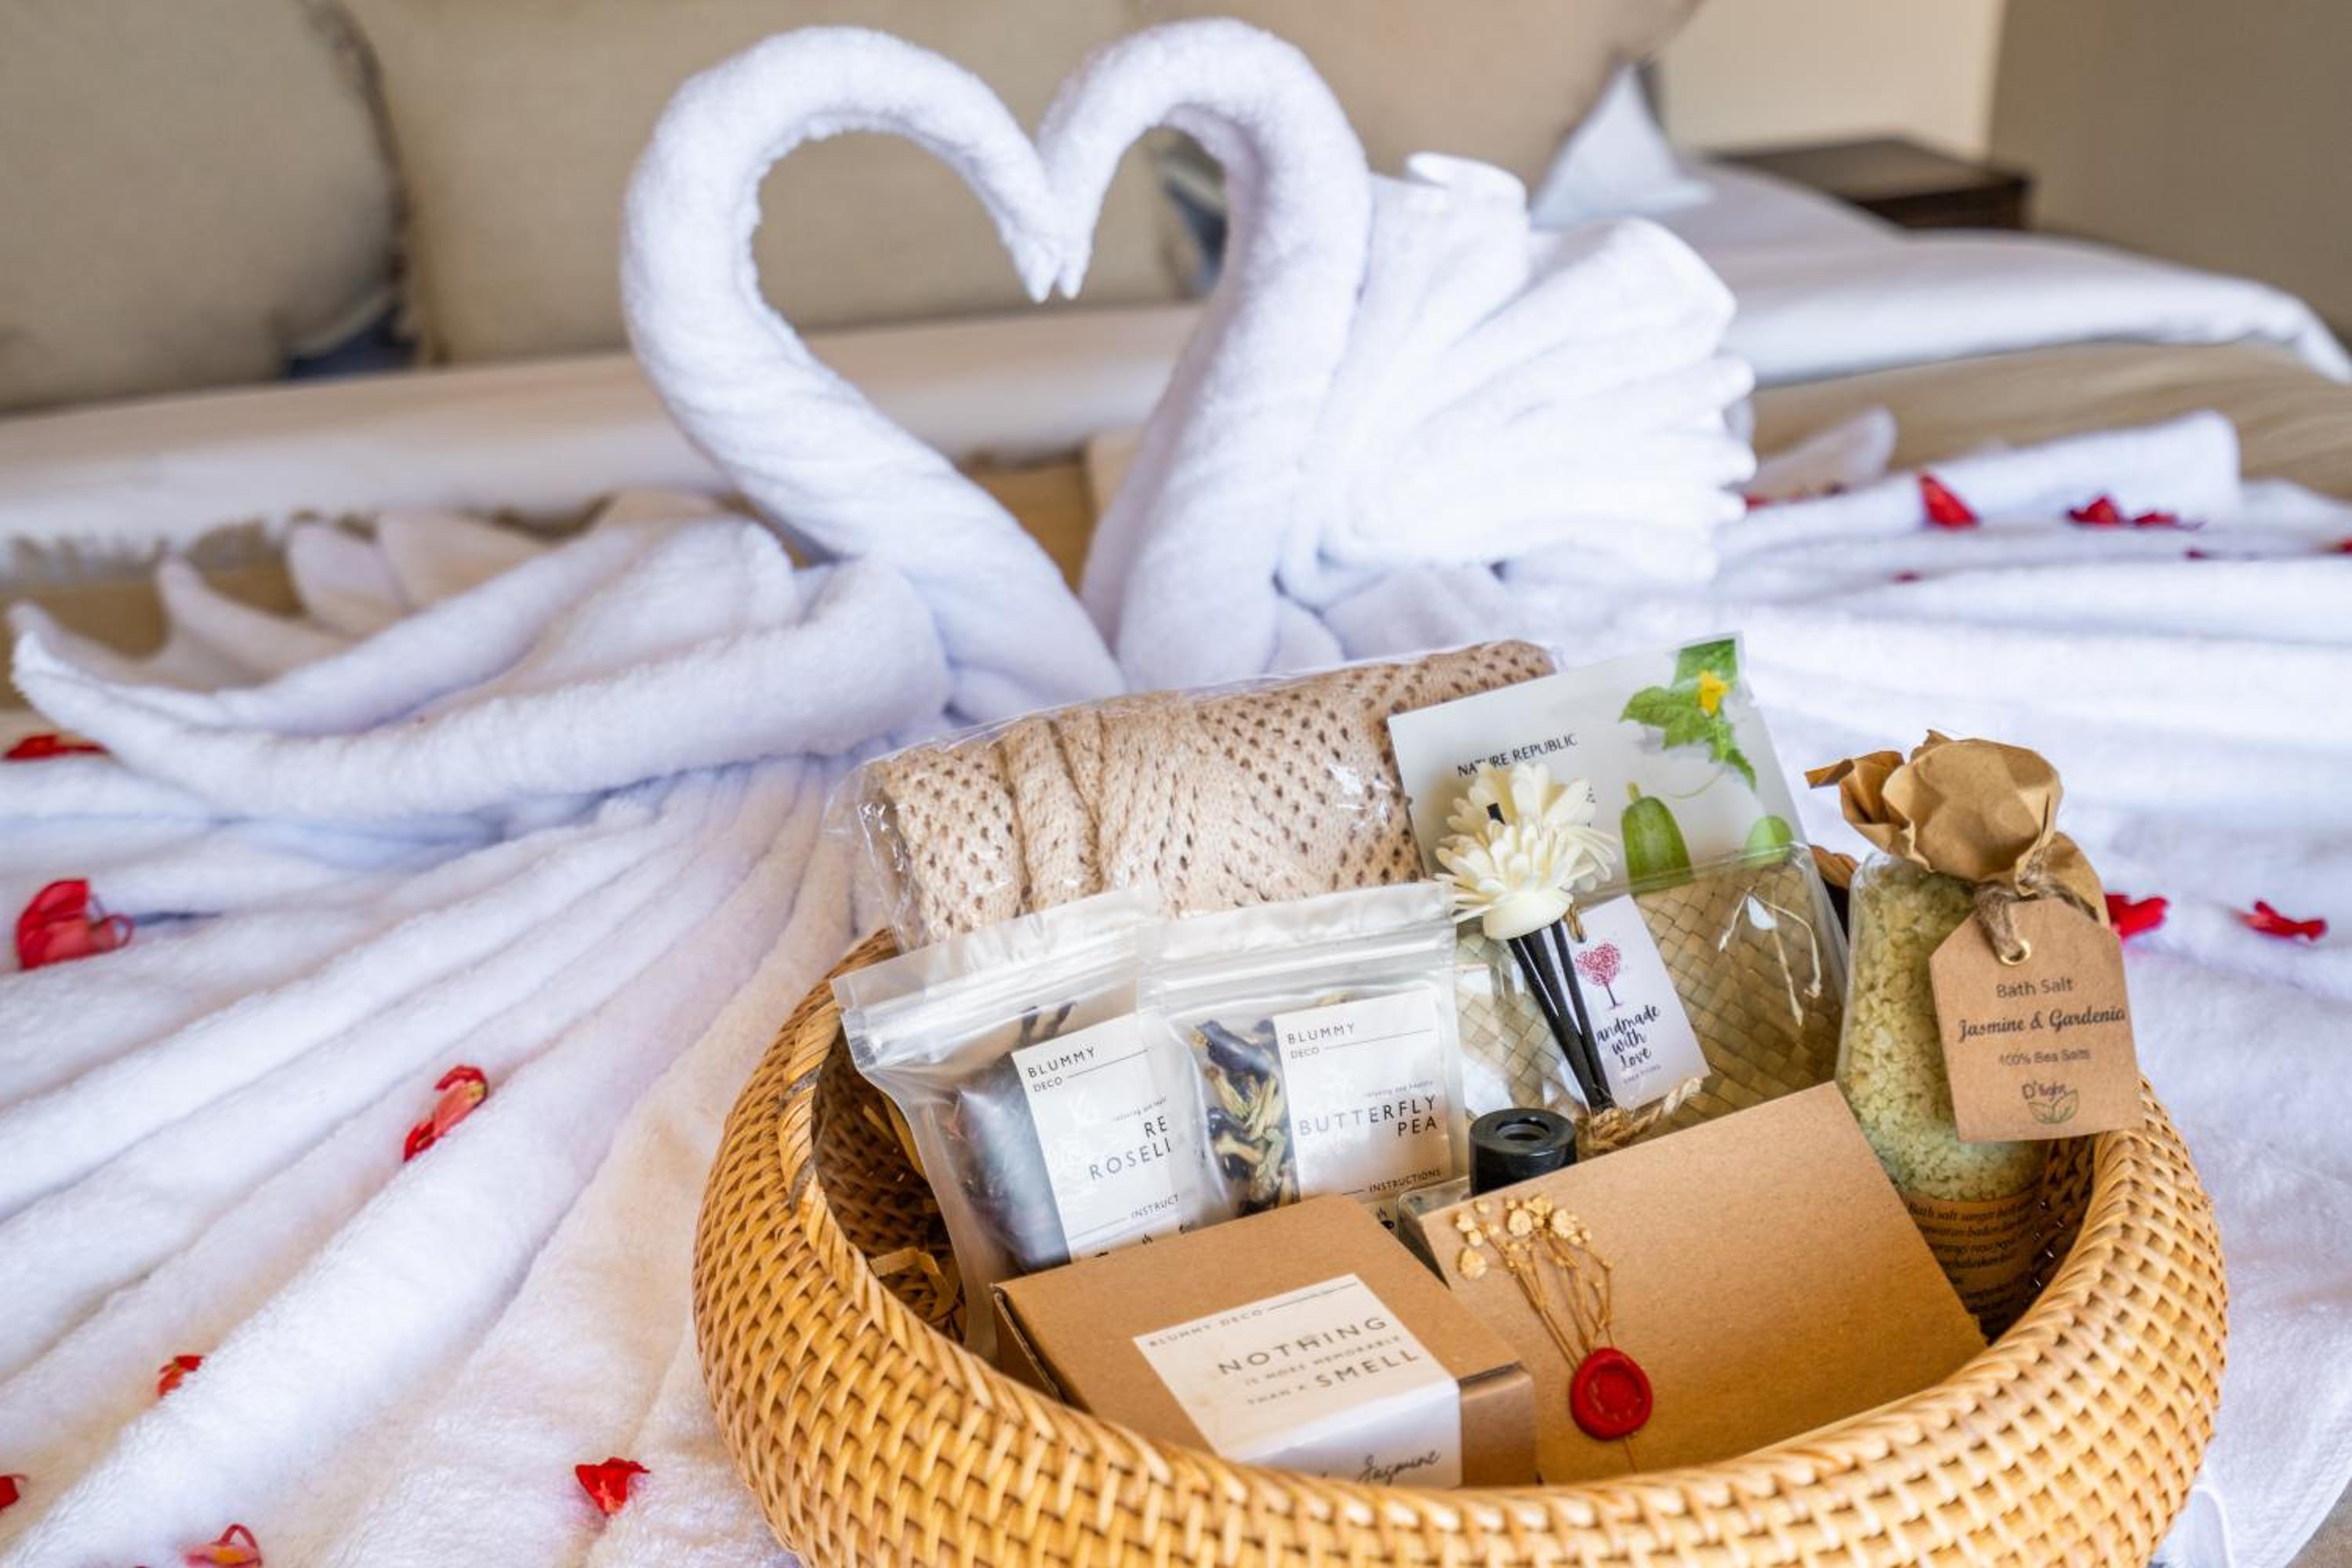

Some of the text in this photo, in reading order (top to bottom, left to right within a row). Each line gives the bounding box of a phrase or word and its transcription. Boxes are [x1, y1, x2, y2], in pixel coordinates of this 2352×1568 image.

[1512, 733, 1578, 760] REPUBLIC
[1995, 978, 2074, 998] Bath Salt
[1287, 1022, 1355, 1045] BLUMMY
[1596, 1004, 1661, 1043] andmade
[1958, 1005, 2127, 1044] Jasmine & Gardenia
[1290, 1047, 1320, 1059] DECO
[1612, 1029, 1647, 1055] with
[1027, 1047, 1095, 1079] BLUMMY
[1033, 1076, 1064, 1093] DECO
[1143, 1115, 1168, 1138] RE
[1298, 1094, 1436, 1137] BUTTERFLY
[1397, 1116, 1437, 1138] PEA
[1369, 1168, 1443, 1193] INSTRUCTIONS
[1131, 1193, 1180, 1218] INSTRUCT
[1149, 1308, 1263, 1347] BLUMMY DECO
[1218, 1316, 1387, 1374] NOTHING
[1314, 1348, 1419, 1388] SMELL
